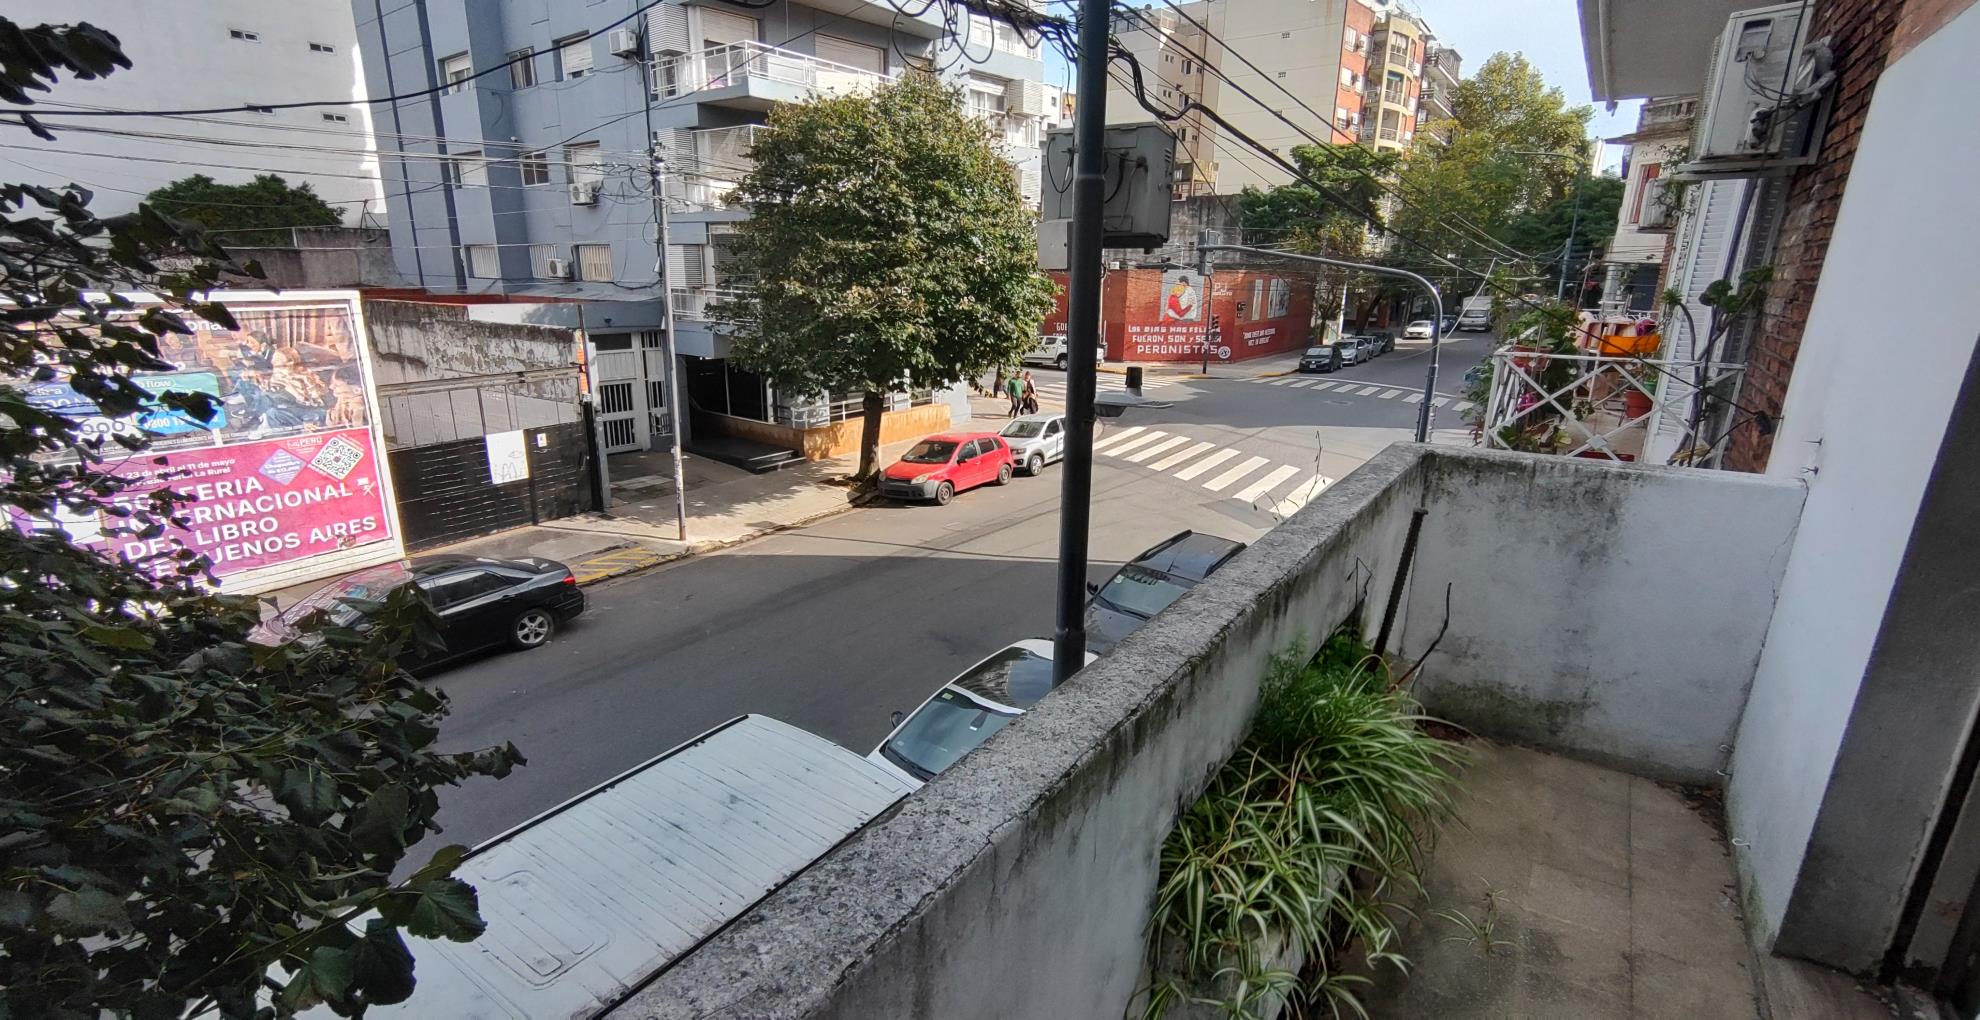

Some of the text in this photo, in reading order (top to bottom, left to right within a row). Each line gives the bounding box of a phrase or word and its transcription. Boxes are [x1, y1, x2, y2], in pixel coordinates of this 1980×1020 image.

[1167, 335, 1186, 343] SON
[1137, 345, 1218, 354] PERONISTAS
[198, 461, 209, 469] de
[211, 458, 236, 467] mayo
[207, 466, 231, 476] Rural
[117, 482, 353, 538] INERNACIONAL
[195, 516, 279, 546] LIBRO
[184, 532, 301, 570] UENOS
[309, 516, 377, 544] AIRES
